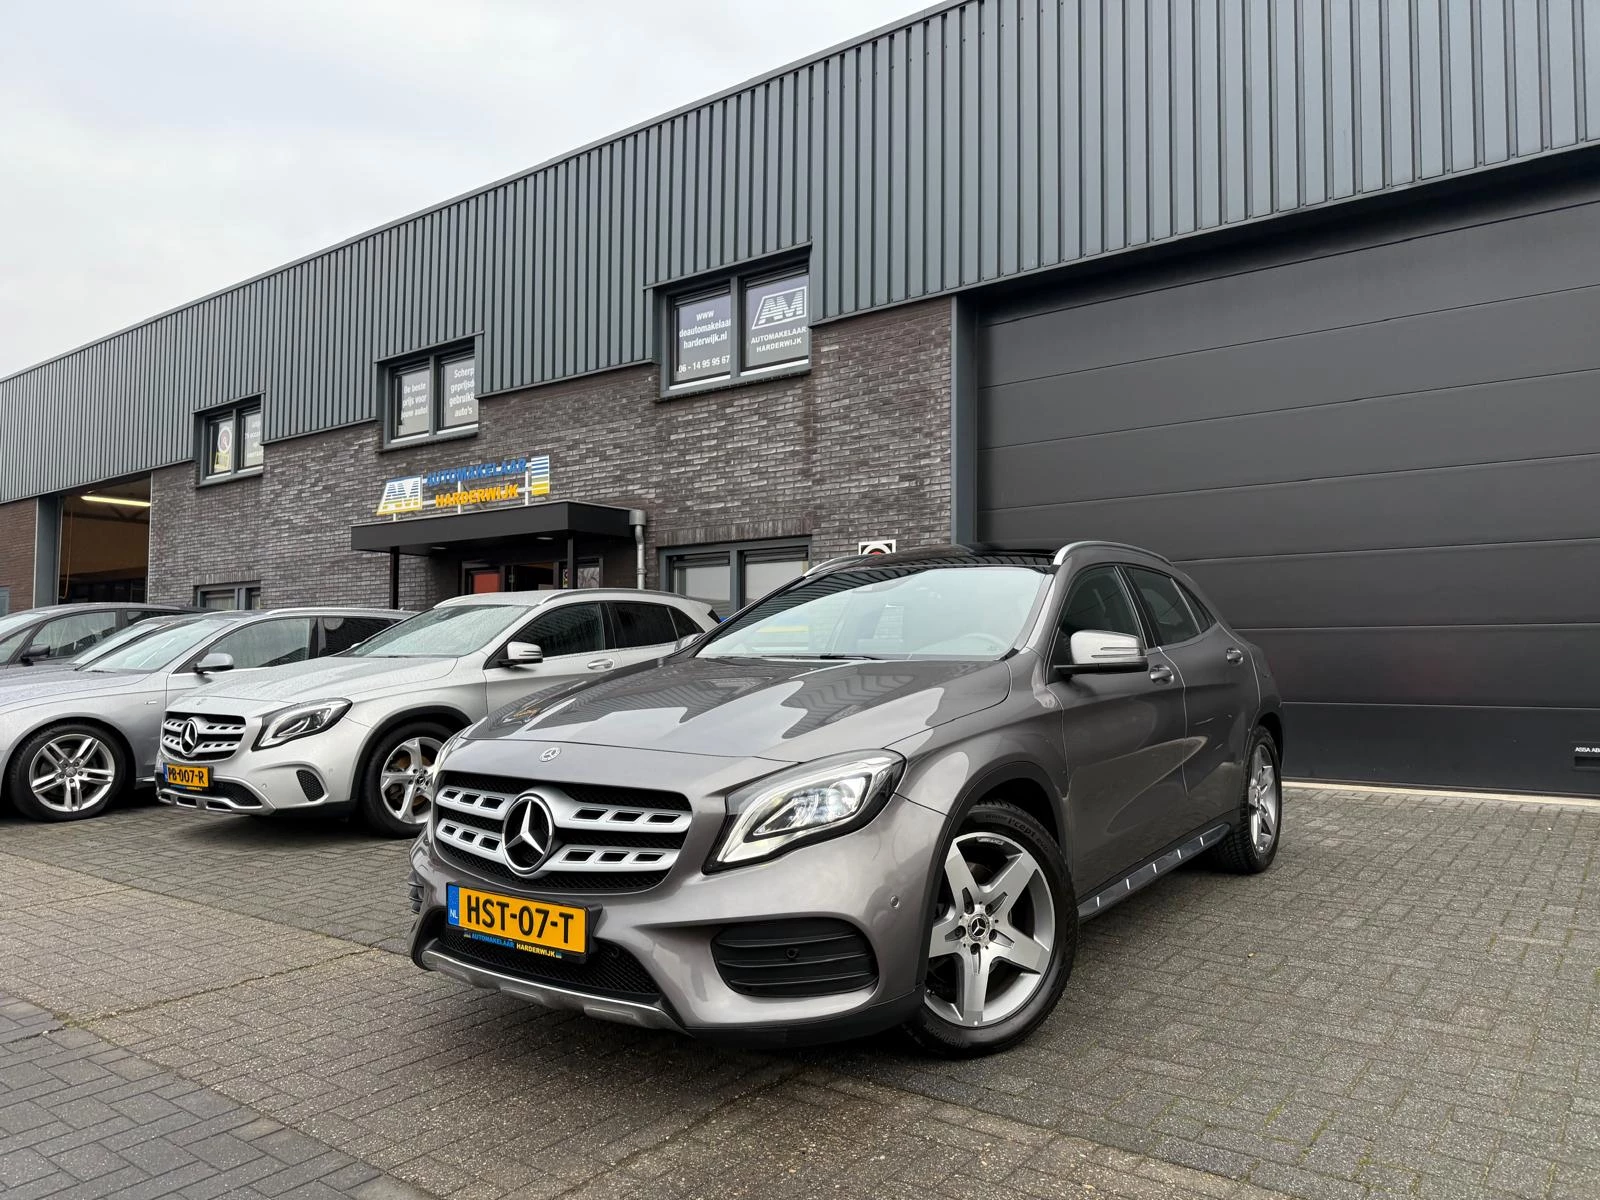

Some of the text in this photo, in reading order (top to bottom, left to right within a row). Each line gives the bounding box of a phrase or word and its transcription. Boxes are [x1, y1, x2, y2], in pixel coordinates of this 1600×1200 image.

[683, 331, 728, 349] harderwijk.nl
[751, 326, 807, 344] AUTOMAKELAAR
[756, 337, 802, 353] HARDERWIJK
[426, 458, 528, 487] AUTOMAKELAAR
[435, 483, 519, 508] HARDERWIJK
[450, 908, 459, 920] NL
[467, 894, 574, 944] HST-07-T
[471, 932, 556, 958] AUTOMAKELAAR HARDERWIJK
